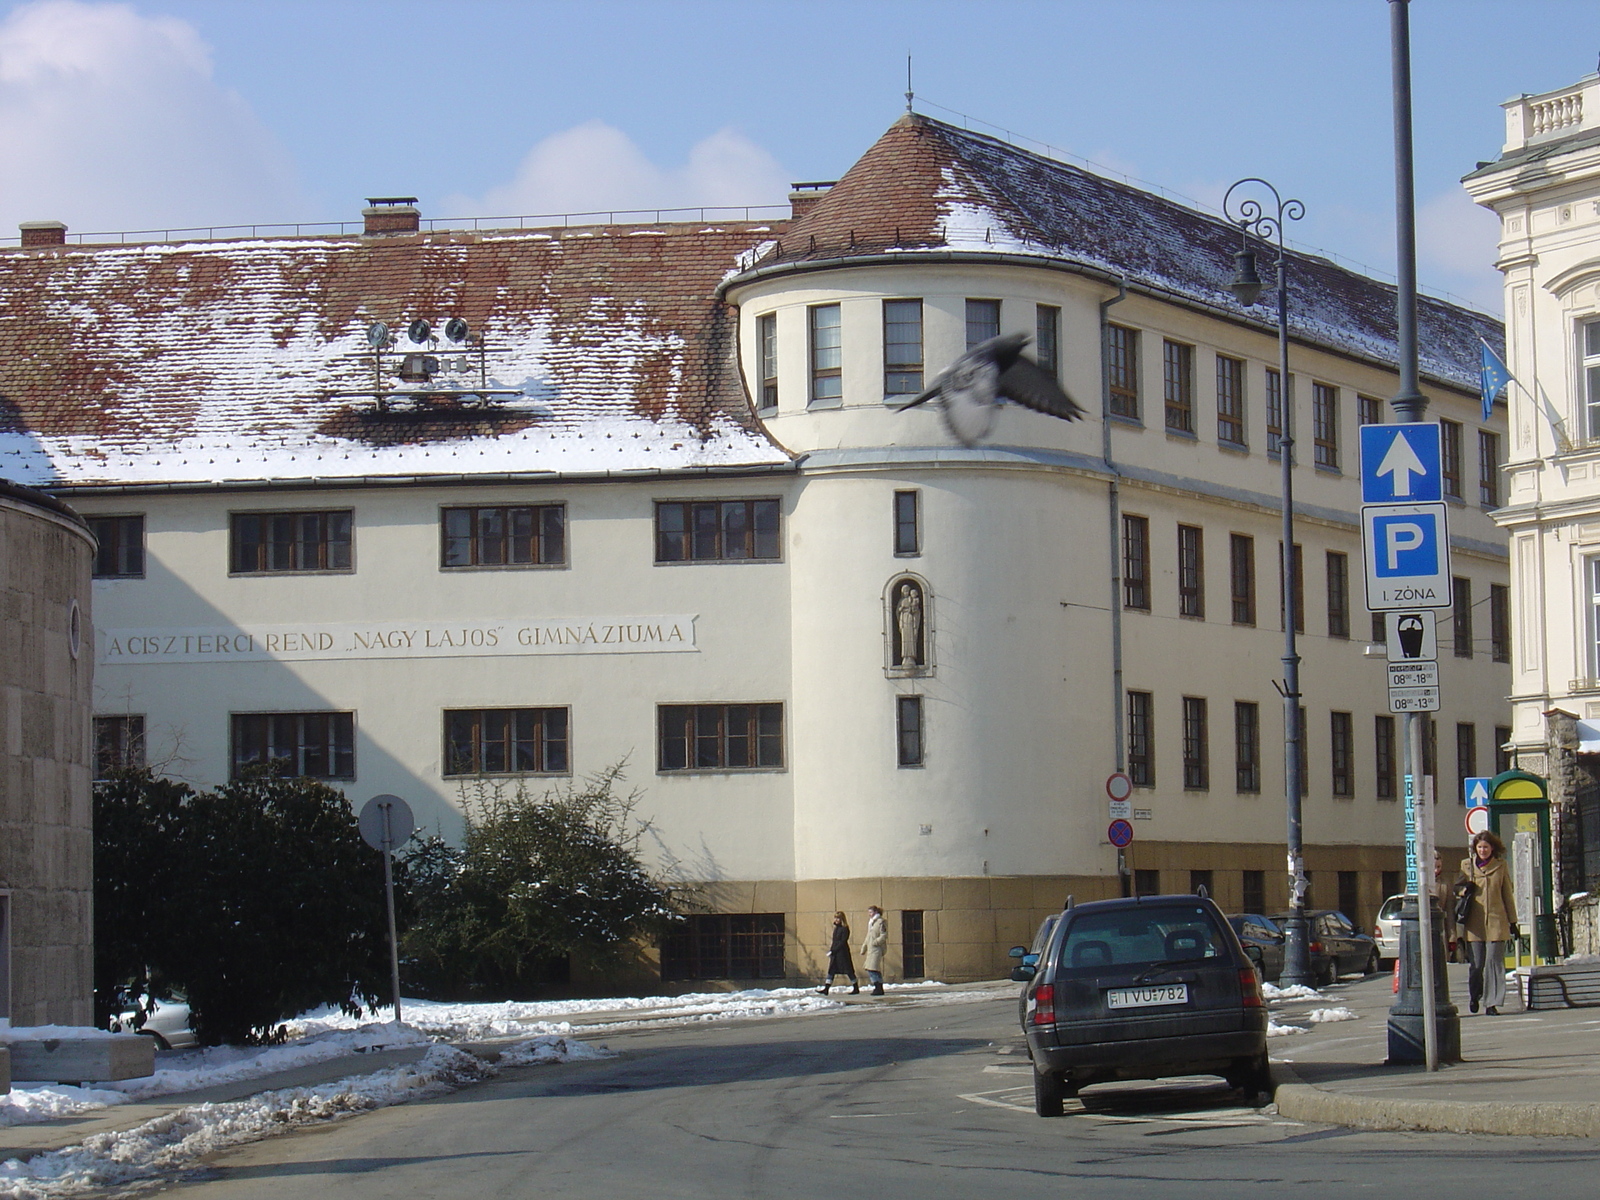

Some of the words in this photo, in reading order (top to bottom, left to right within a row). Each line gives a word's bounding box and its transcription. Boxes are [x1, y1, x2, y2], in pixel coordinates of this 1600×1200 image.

[1385, 522, 1424, 570] P
[1394, 585, 1436, 601] ZÓNA
[108, 639, 124, 656] A
[127, 634, 254, 655] CISZTERCI
[266, 632, 334, 653] REND
[517, 622, 686, 647] GIMNÁZIUMA
